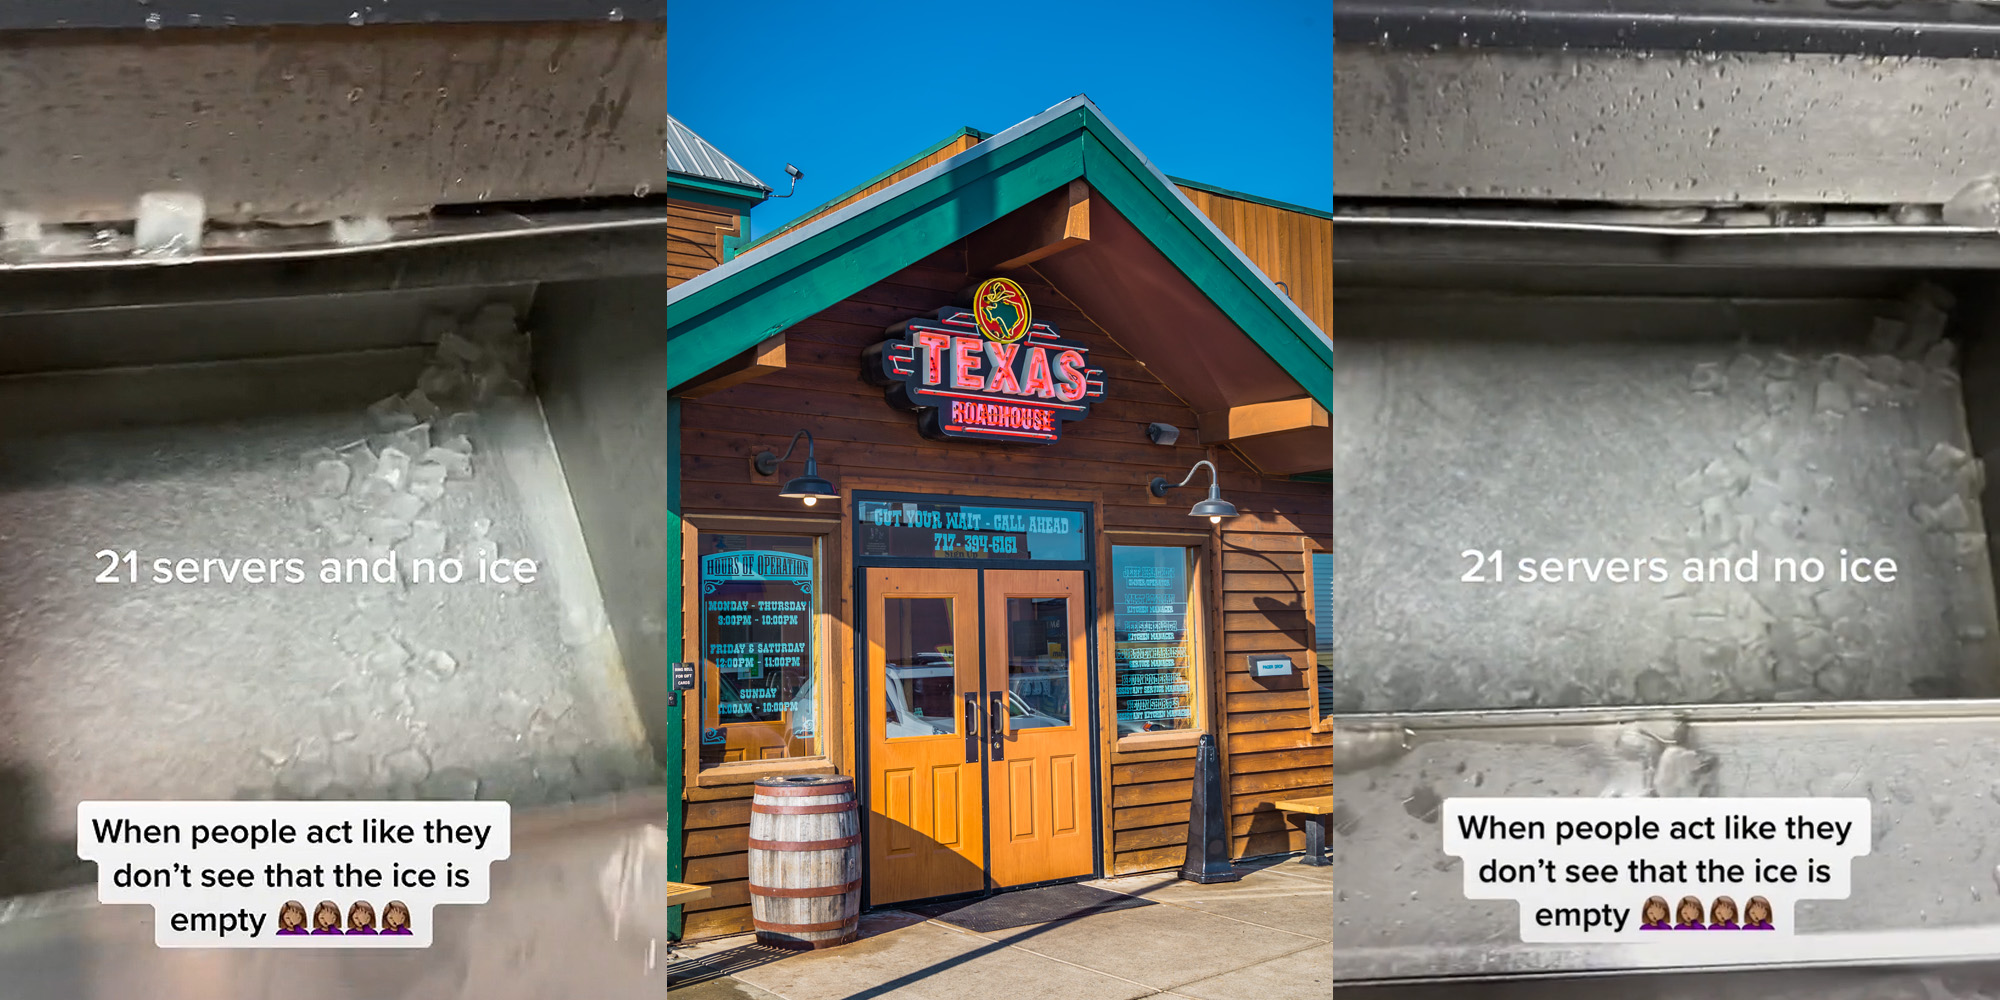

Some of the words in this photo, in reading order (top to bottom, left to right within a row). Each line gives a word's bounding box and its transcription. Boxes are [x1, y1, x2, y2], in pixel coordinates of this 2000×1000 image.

[914, 331, 1087, 402] TEXAS
[951, 401, 1056, 431] ROADHOUSE
[874, 508, 902, 527] CUT
[906, 510, 942, 529] YOUR
[946, 512, 981, 530] WAIT
[994, 514, 1025, 532] CALL
[1029, 516, 1068, 534] AHEAD
[964, 535, 1017, 553] 394-6161
[706, 556, 740, 576] HOURS
[742, 554, 754, 577] OF
[757, 554, 809, 577] OPERATION
[708, 601, 749, 611] MONDAY
[758, 601, 807, 611] THURSDAY
[762, 615, 798, 625] 10:00PM
[710, 644, 746, 654] FRIDAY
[748, 644, 755, 653] &
[757, 643, 806, 653] SATURDAY
[716, 658, 754, 668] 12:00PM
[764, 657, 800, 667] 11:00PM
[740, 688, 777, 699] SUNDAY
[718, 703, 753, 714] 11:00AM
[763, 702, 799, 712] 10:00PM
